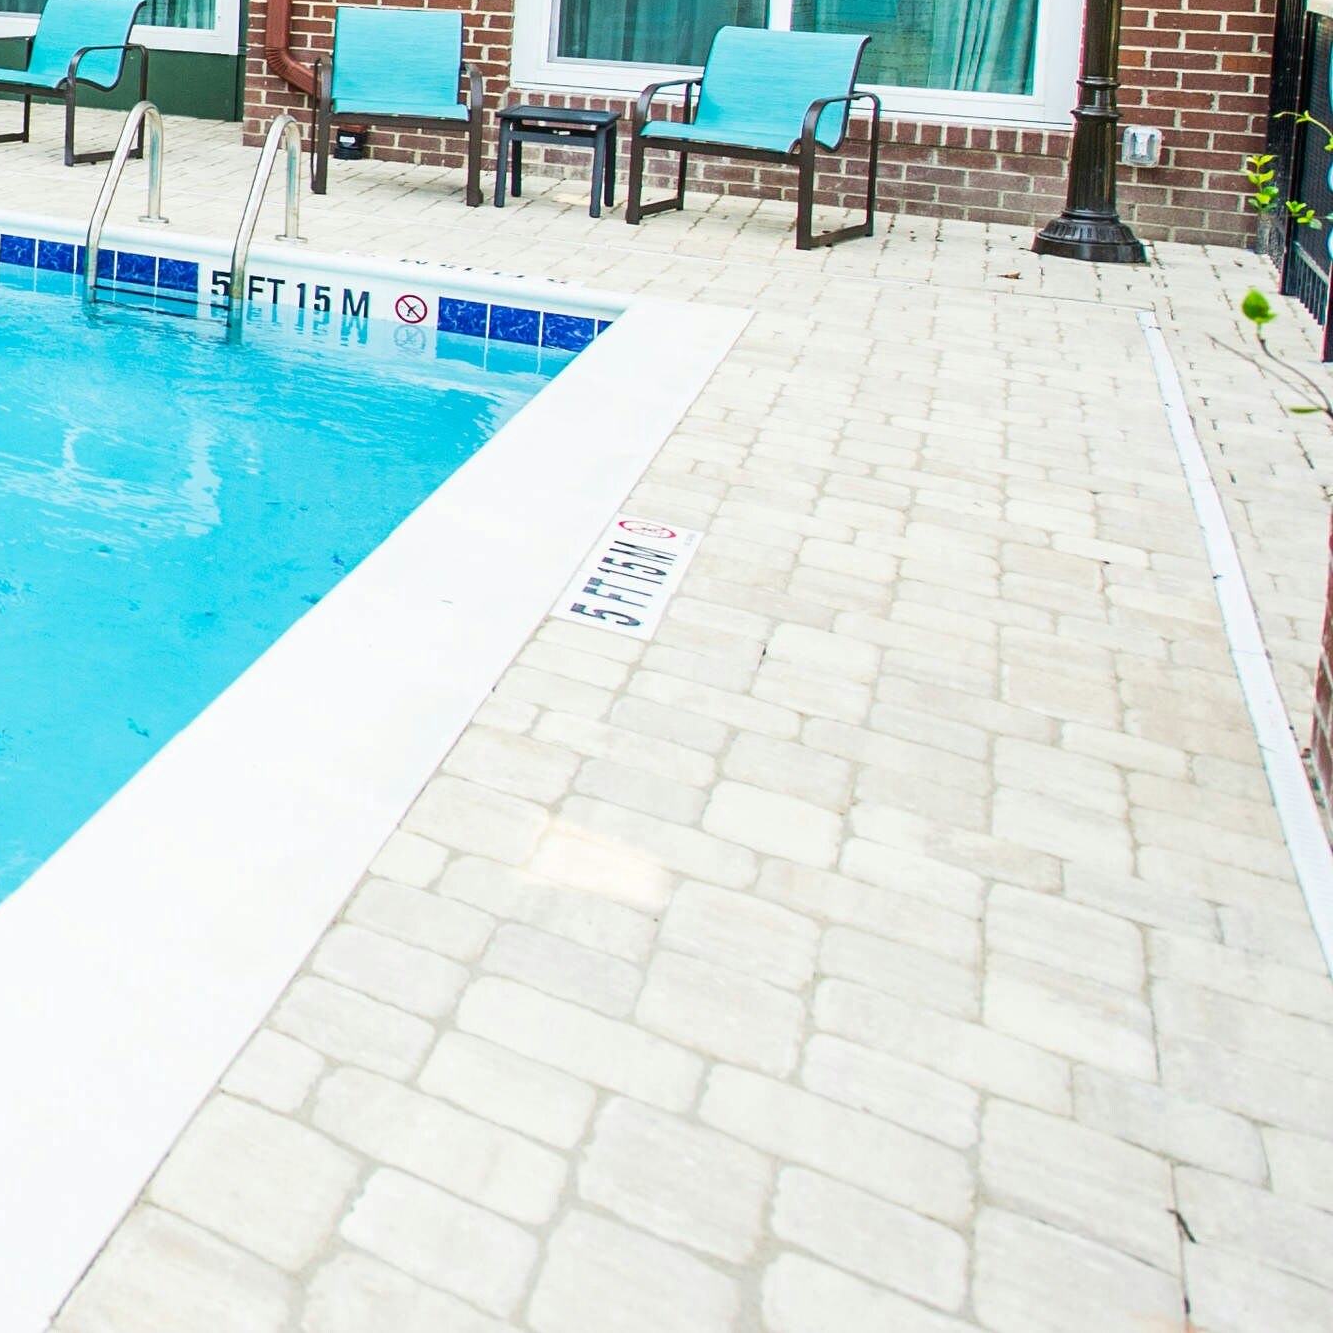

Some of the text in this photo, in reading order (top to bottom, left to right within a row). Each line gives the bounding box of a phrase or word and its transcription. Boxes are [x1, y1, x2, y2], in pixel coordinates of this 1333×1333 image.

[211, 270, 231, 296] 5
[248, 275, 285, 304] FT
[342, 288, 370, 318] M
[609, 540, 678, 566] M
[582, 577, 653, 608] FT
[570, 602, 641, 626] 5
